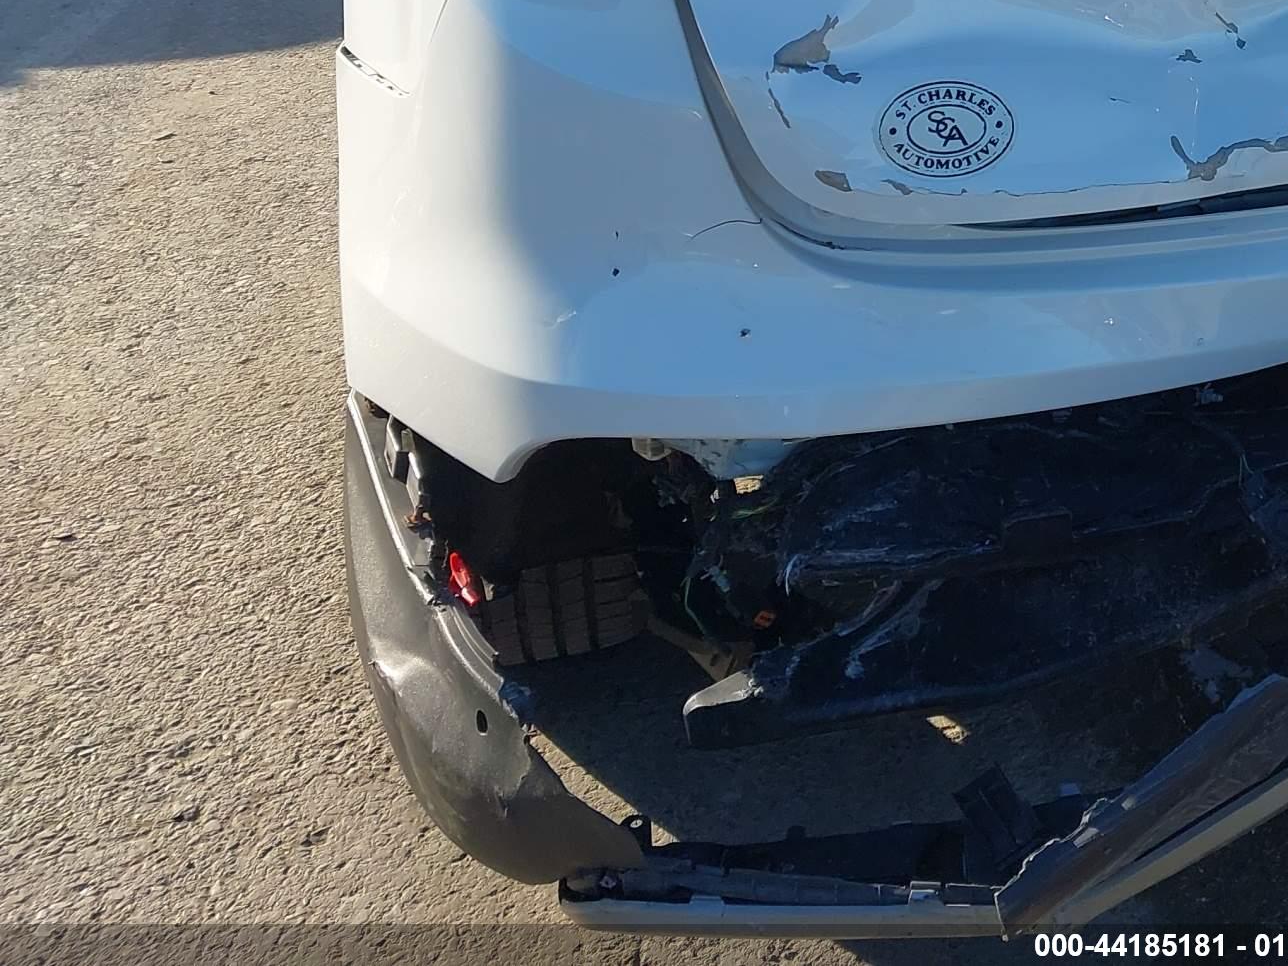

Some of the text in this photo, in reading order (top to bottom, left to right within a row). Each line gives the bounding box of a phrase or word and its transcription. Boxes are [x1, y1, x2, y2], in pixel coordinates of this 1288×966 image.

[895, 88, 996, 120] ST. CHARLES
[893, 135, 1000, 170] AUTOMOTIVE
